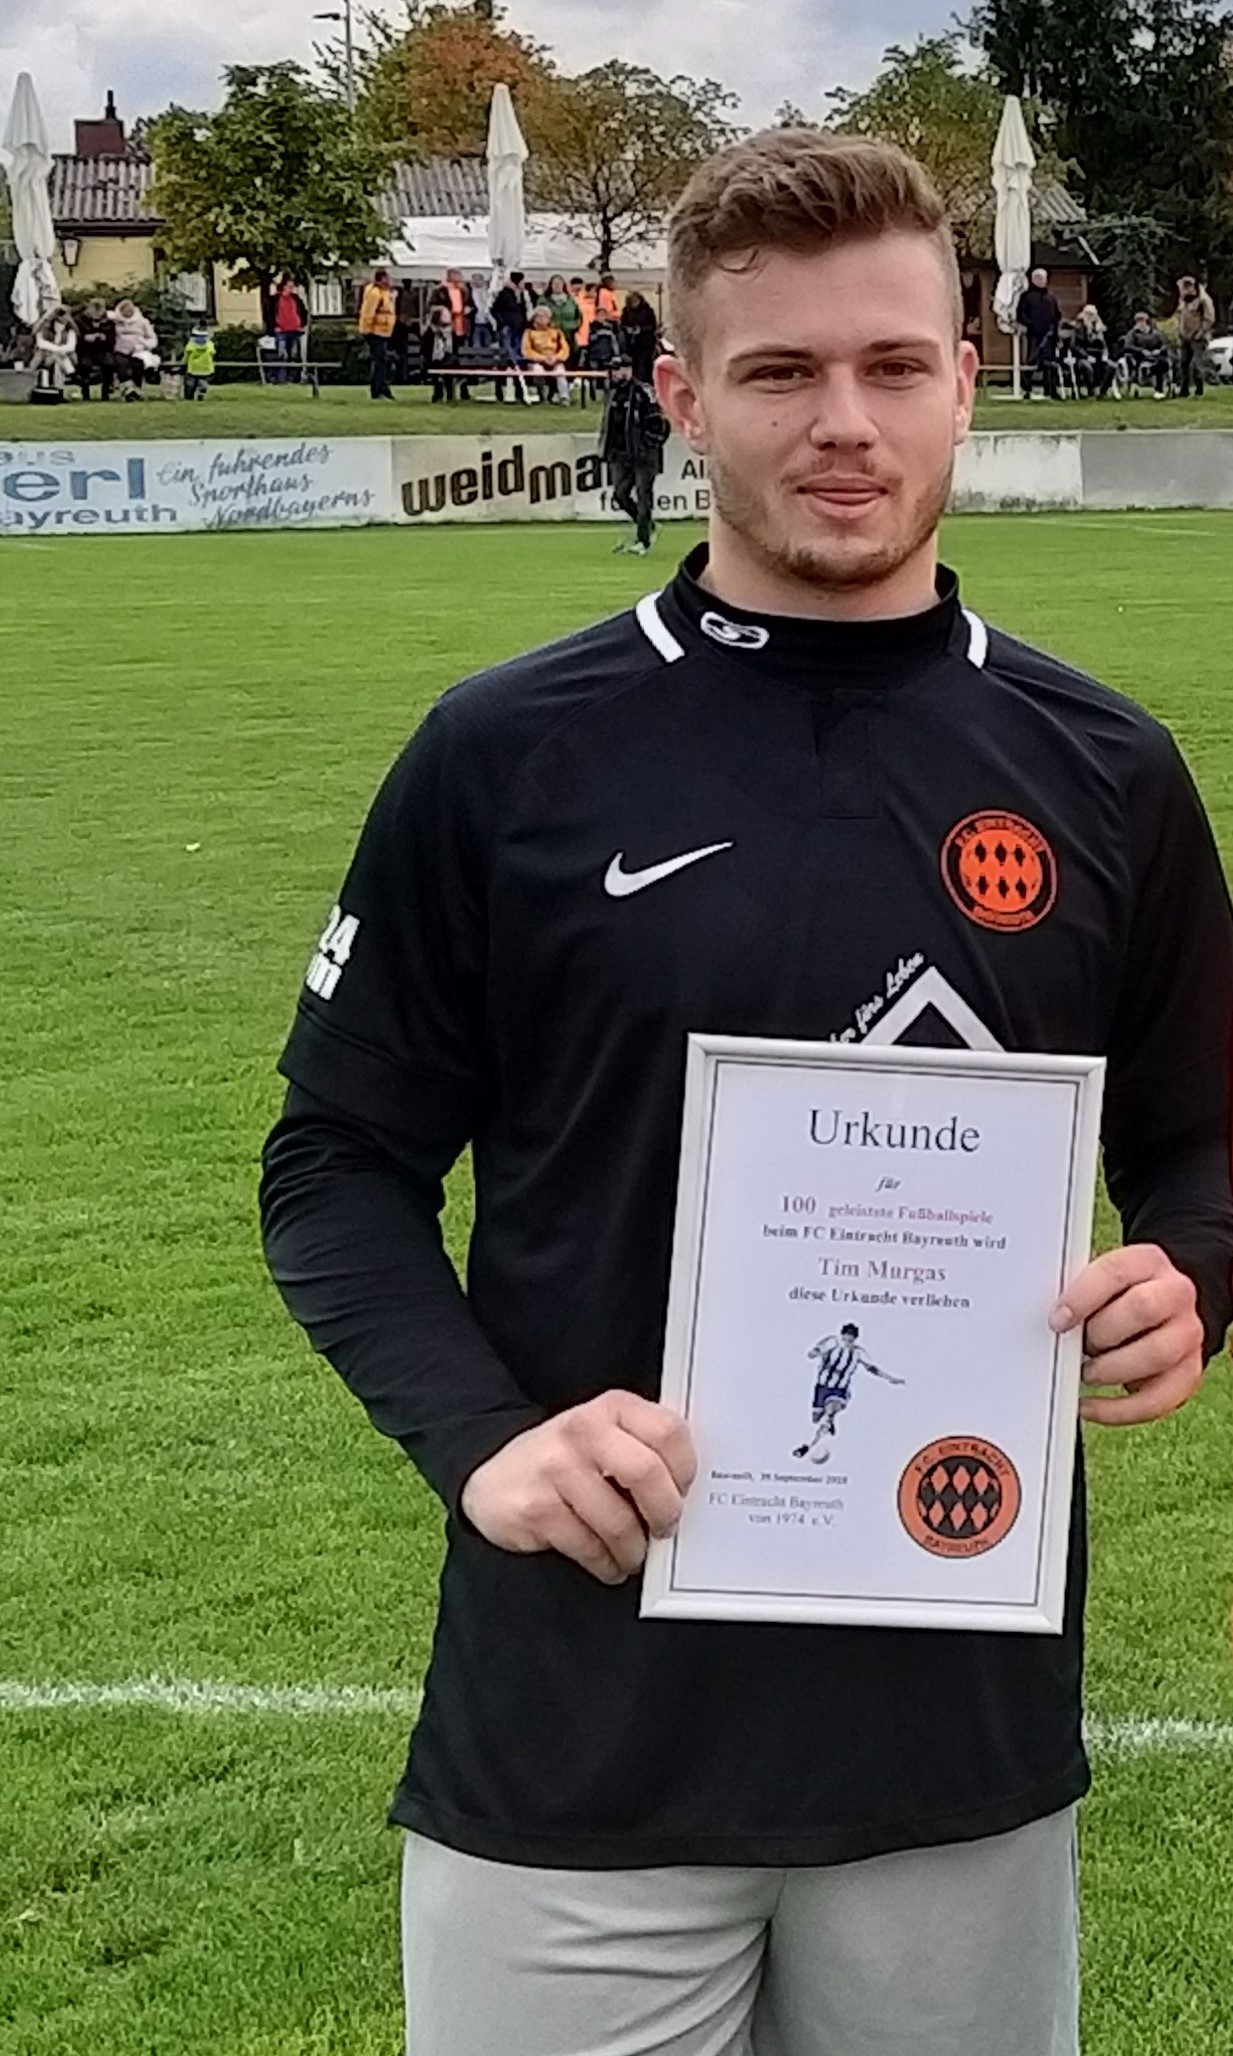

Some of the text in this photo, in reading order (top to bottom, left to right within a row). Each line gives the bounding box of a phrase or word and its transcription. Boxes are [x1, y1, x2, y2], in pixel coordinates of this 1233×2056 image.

[3, 458, 146, 502] erl
[156, 462, 198, 486] Ein
[189, 473, 313, 508] Sporthaus
[202, 488, 376, 530] Nordbayerns
[809, 1108, 981, 1153] Urkunde
[875, 1175, 901, 1194] für
[783, 1195, 817, 1215] 100
[763, 1223, 1006, 1250] beim FC Eintracht Bayreuth wird
[818, 1257, 946, 1285] Tim Murgas
[789, 1286, 971, 1309] diese Urkunde verliehen
